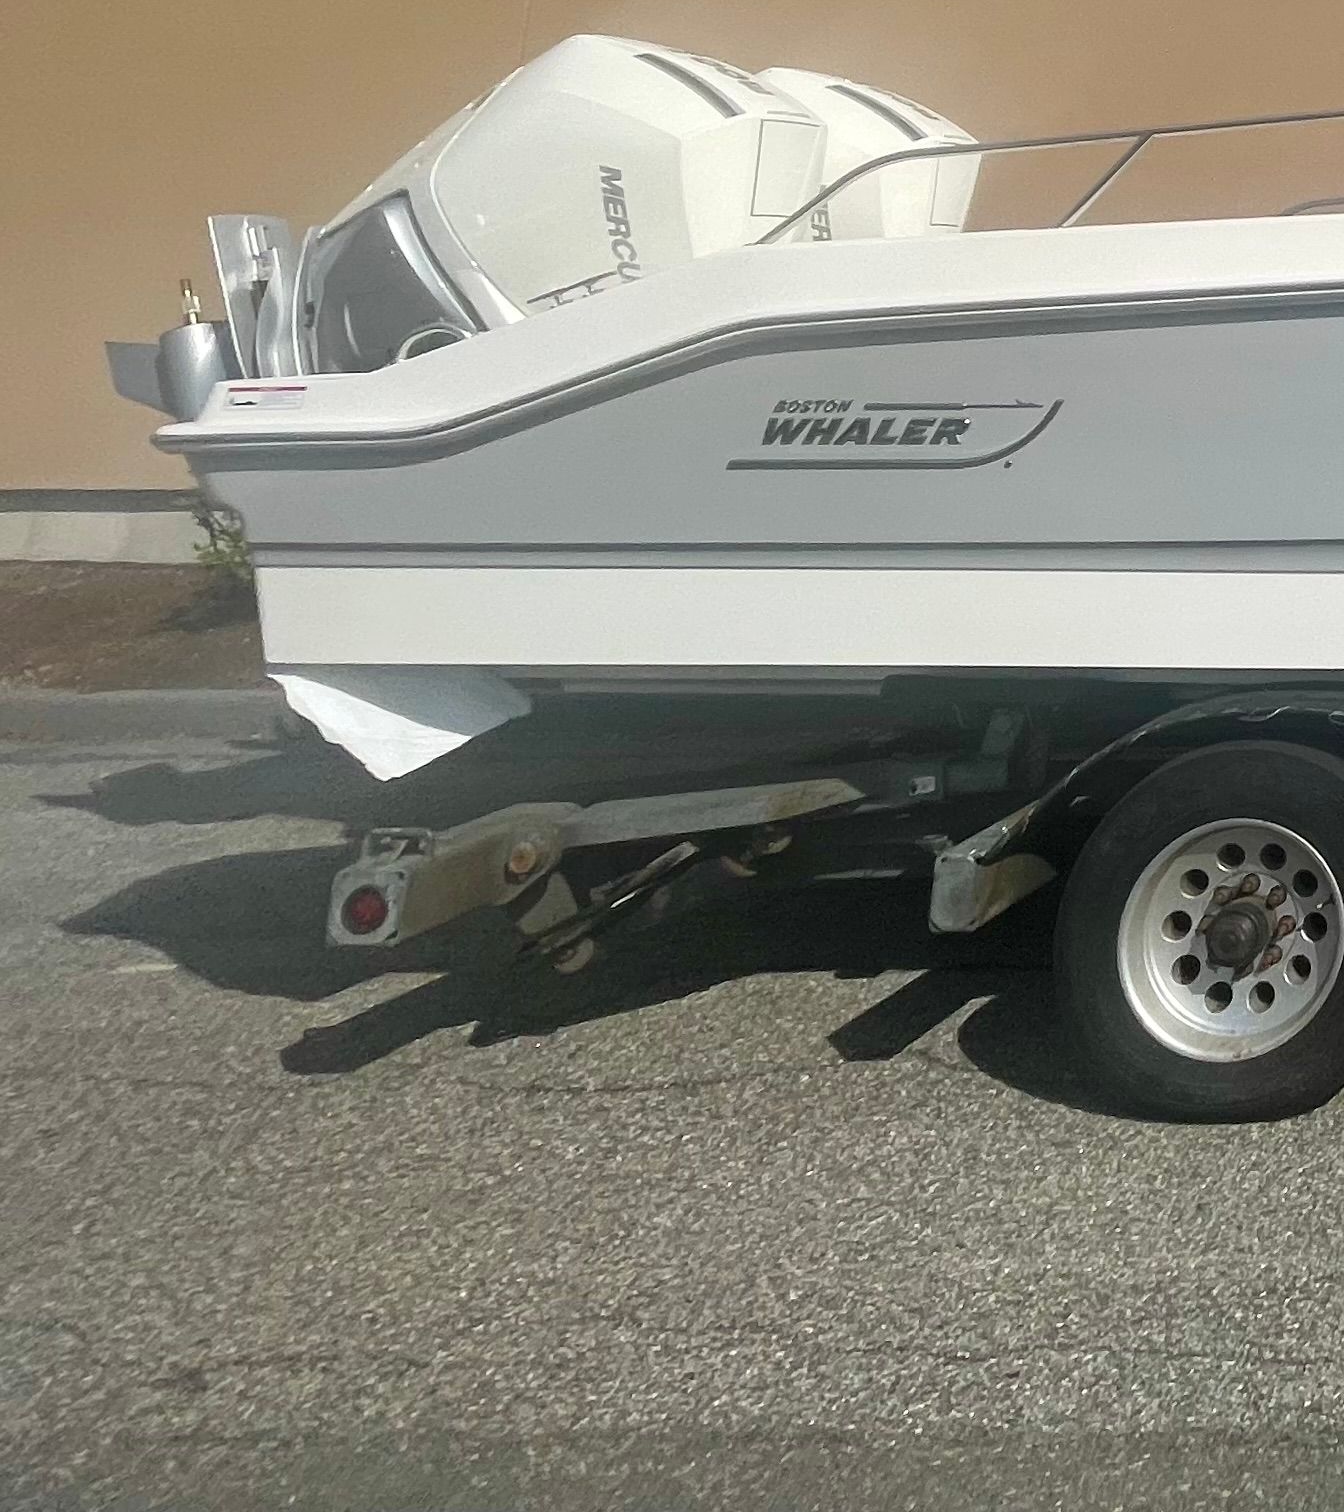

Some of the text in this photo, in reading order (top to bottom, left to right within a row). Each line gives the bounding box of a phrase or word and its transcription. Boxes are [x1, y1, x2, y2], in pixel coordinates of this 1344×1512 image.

[599, 164, 642, 284] MERCU
[772, 399, 854, 414] BOSTON
[761, 416, 972, 446] WHALER
